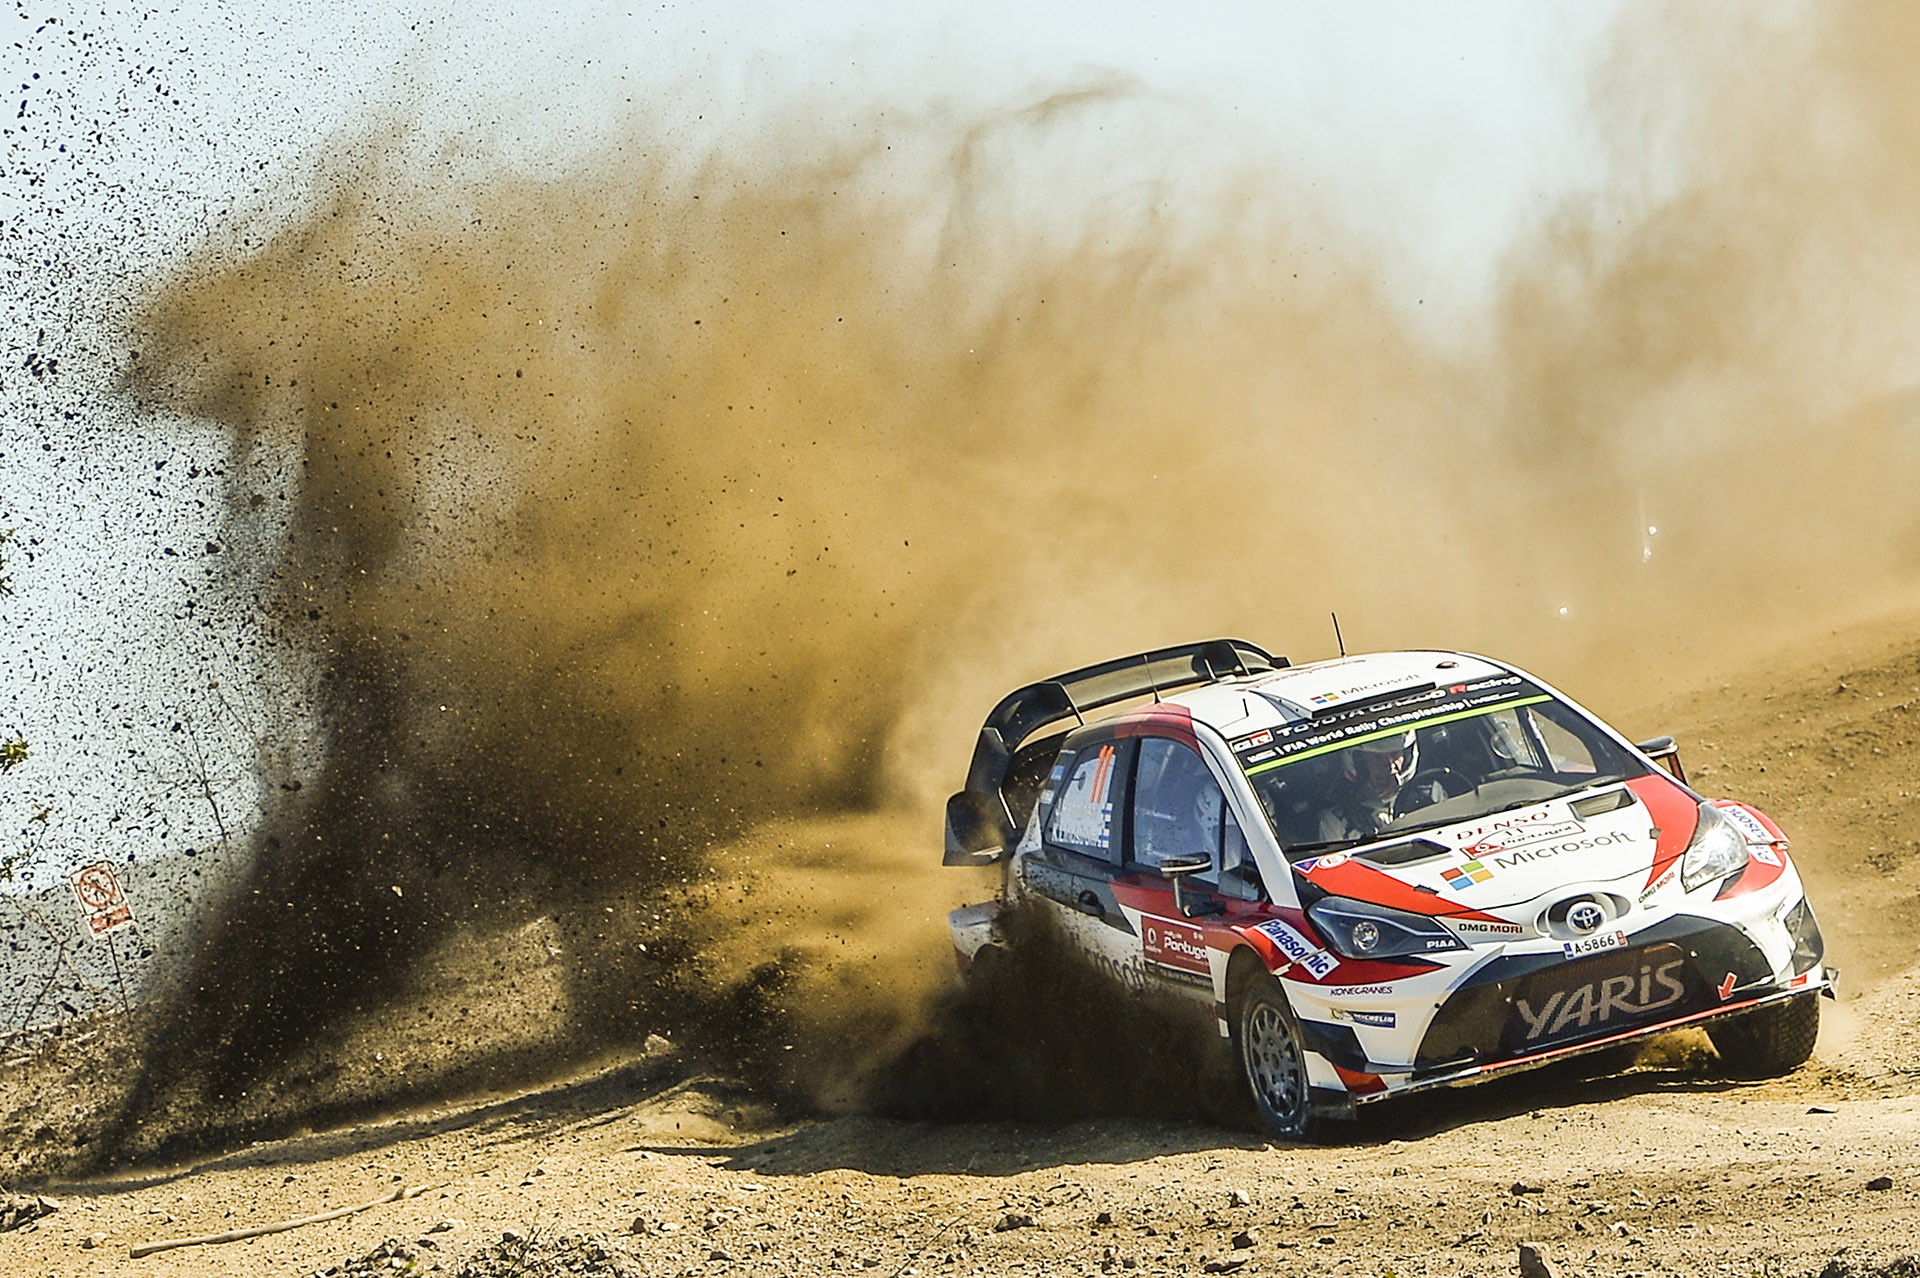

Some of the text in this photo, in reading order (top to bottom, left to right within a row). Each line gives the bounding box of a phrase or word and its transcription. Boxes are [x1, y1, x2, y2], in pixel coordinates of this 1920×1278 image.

[1341, 674, 1421, 695] Microsoft
[1276, 708, 1365, 737] TOYOTA
[1369, 689, 1447, 713] GAZOO
[1449, 676, 1522, 694] Racing
[1282, 699, 1465, 753] FIA World Rally Championship
[1089, 745, 1115, 803] 11
[1457, 812, 1548, 840] DENSO
[1494, 831, 1636, 869] Microsoft
[1638, 886, 1657, 904] DMG
[1458, 923, 1523, 934] DMG MORI
[1164, 936, 1208, 960] Portuga
[1259, 920, 1329, 975] Panasonic
[1426, 939, 1457, 949] PIAA
[1330, 985, 1393, 997] KONECRANES
